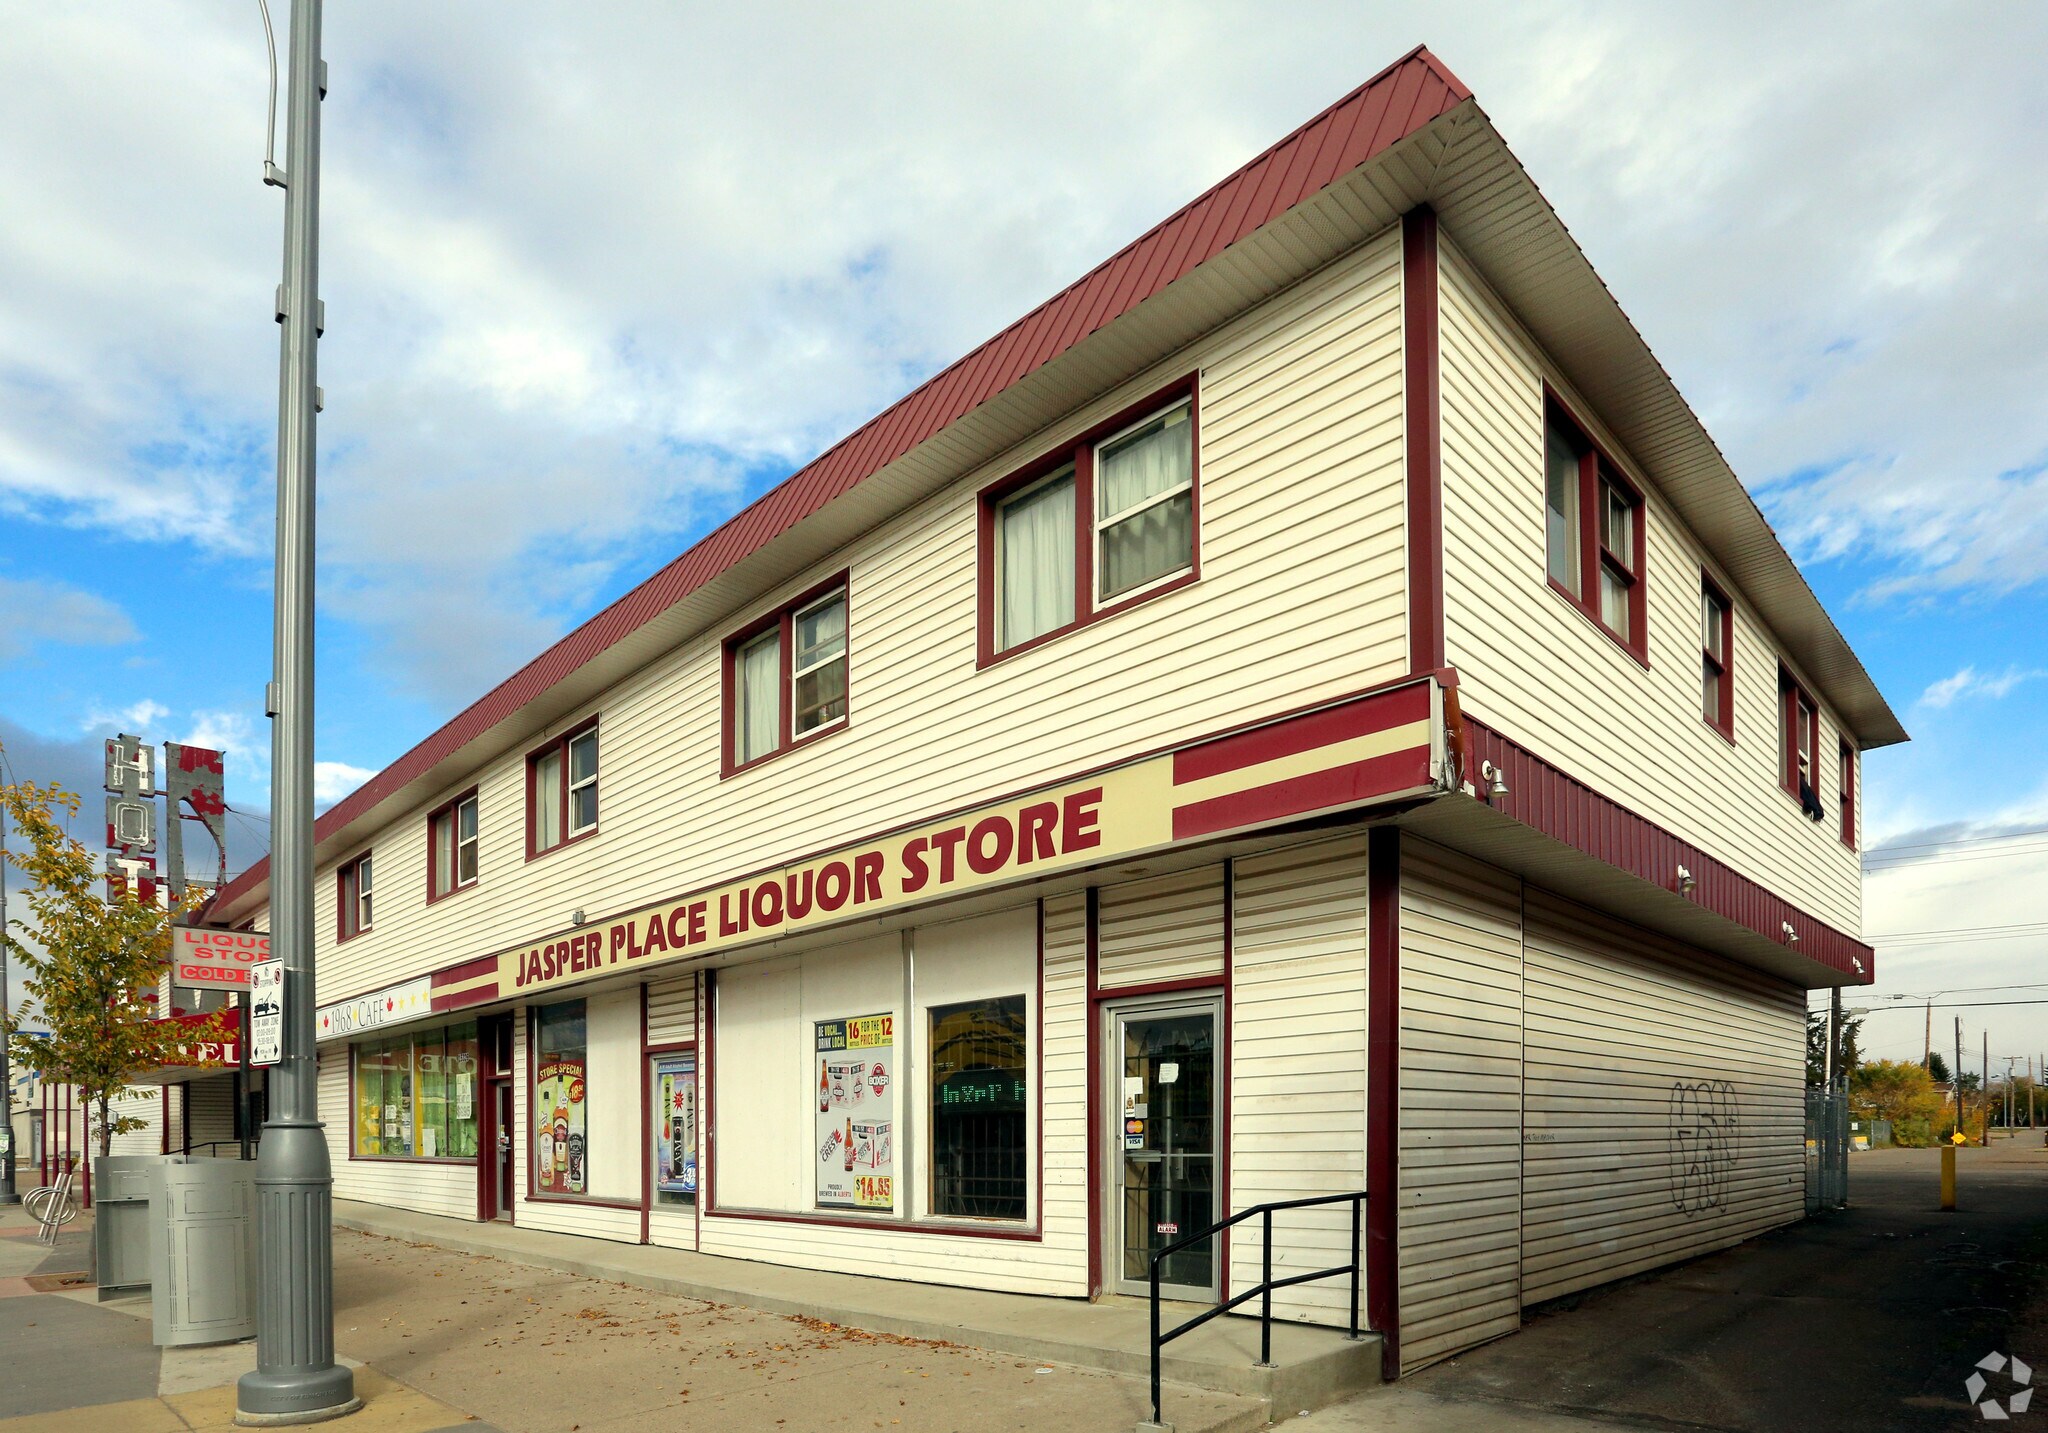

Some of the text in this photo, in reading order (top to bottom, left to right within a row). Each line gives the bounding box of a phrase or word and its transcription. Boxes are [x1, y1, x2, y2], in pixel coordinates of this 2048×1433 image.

[516, 786, 1103, 987] JASPER PLACE LIQUOR STORE
[185, 931, 270, 949] LIQU
[183, 966, 236, 981] COLD
[331, 1005, 352, 1033] 1968
[861, 1020, 879, 1032] FOR THE
[881, 1017, 892, 1035] 12
[848, 1022, 859, 1039] 16
[861, 1033, 880, 1045] PRICE OF
[539, 1063, 583, 1080] STORE SPECIAL
[868, 1076, 889, 1085] BOXER
